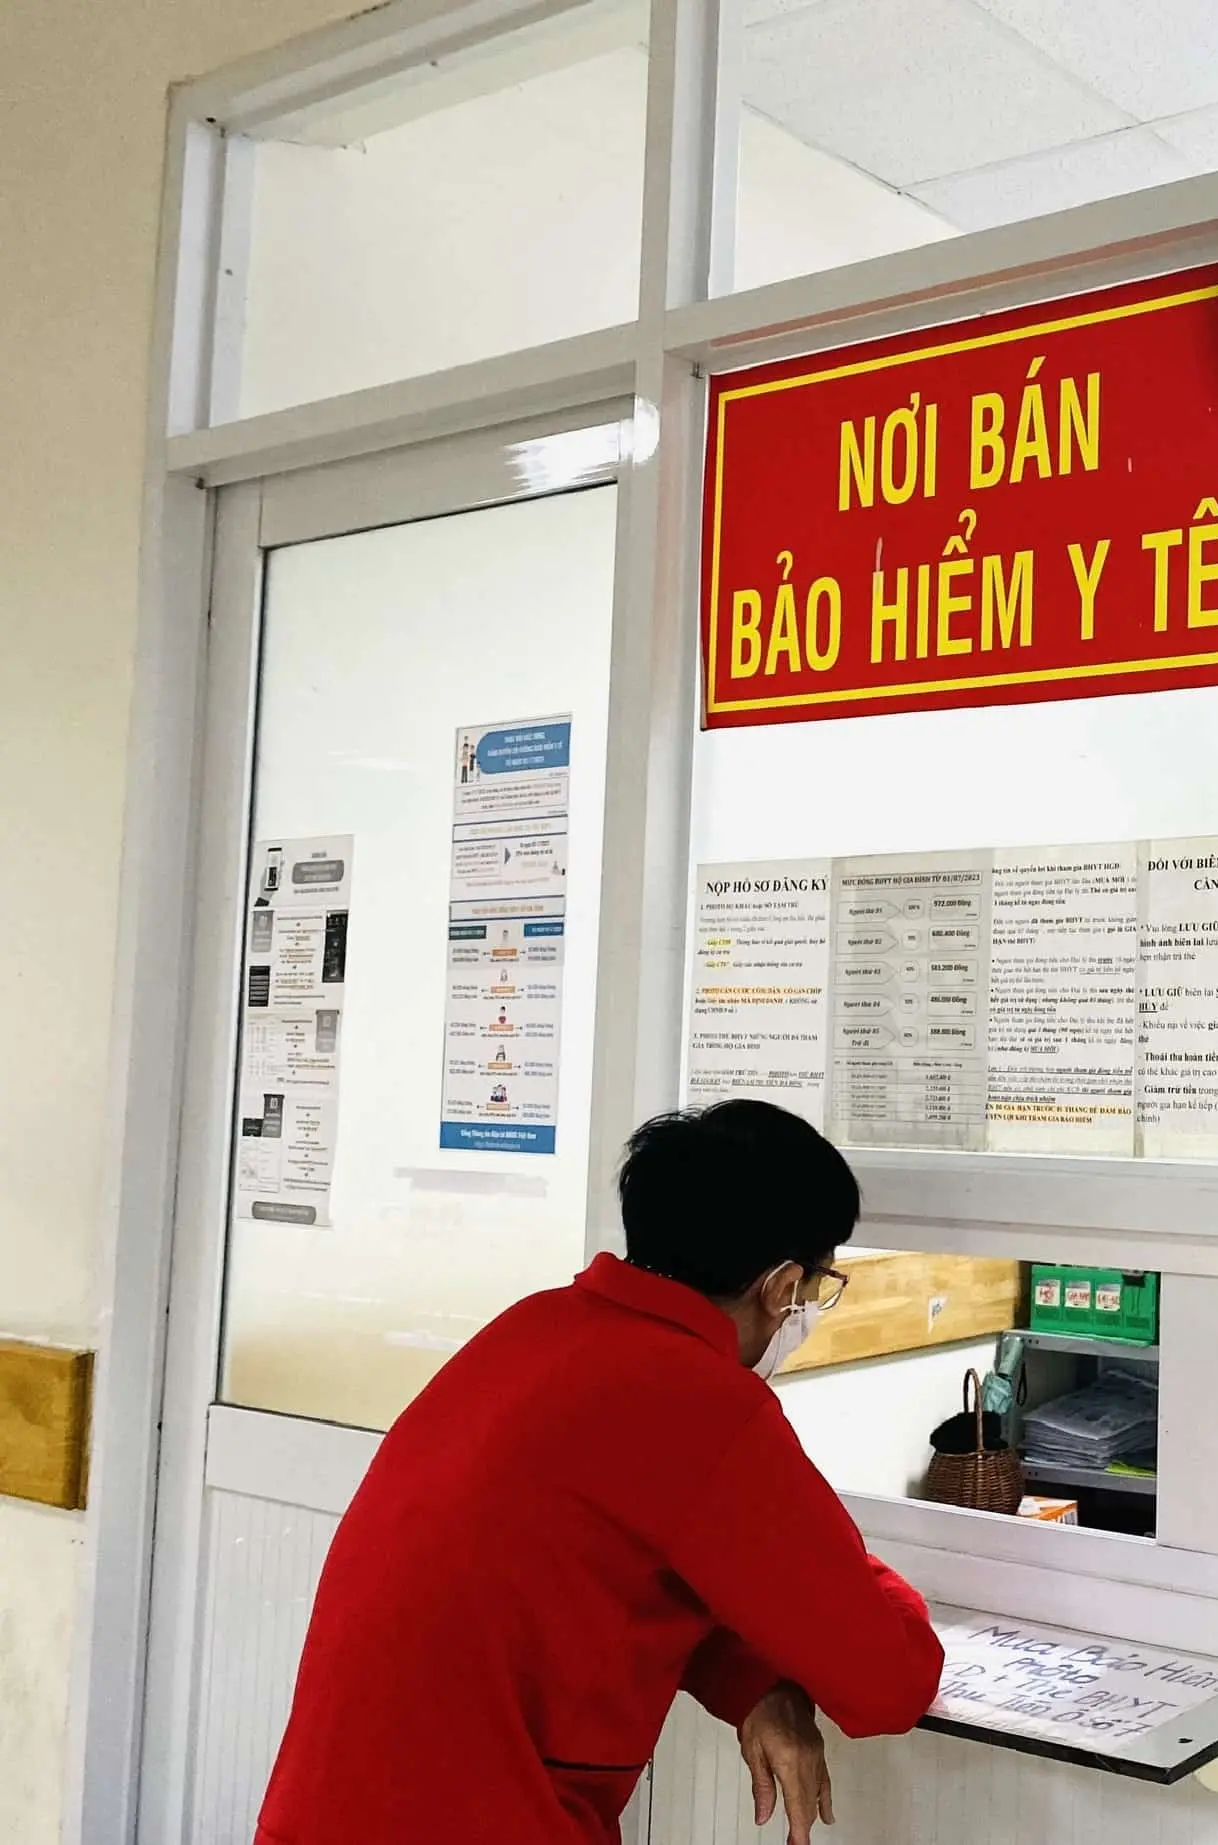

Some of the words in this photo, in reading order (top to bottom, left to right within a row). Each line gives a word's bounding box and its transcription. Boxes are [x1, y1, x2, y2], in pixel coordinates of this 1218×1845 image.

[838, 392, 938, 511] NƠI
[969, 355, 1101, 491] BÁN
[730, 550, 842, 679] BẢO
[870, 508, 1035, 664] HIỂM
[1067, 539, 1110, 640] Y
[968, 1626, 1056, 1655] Mua
